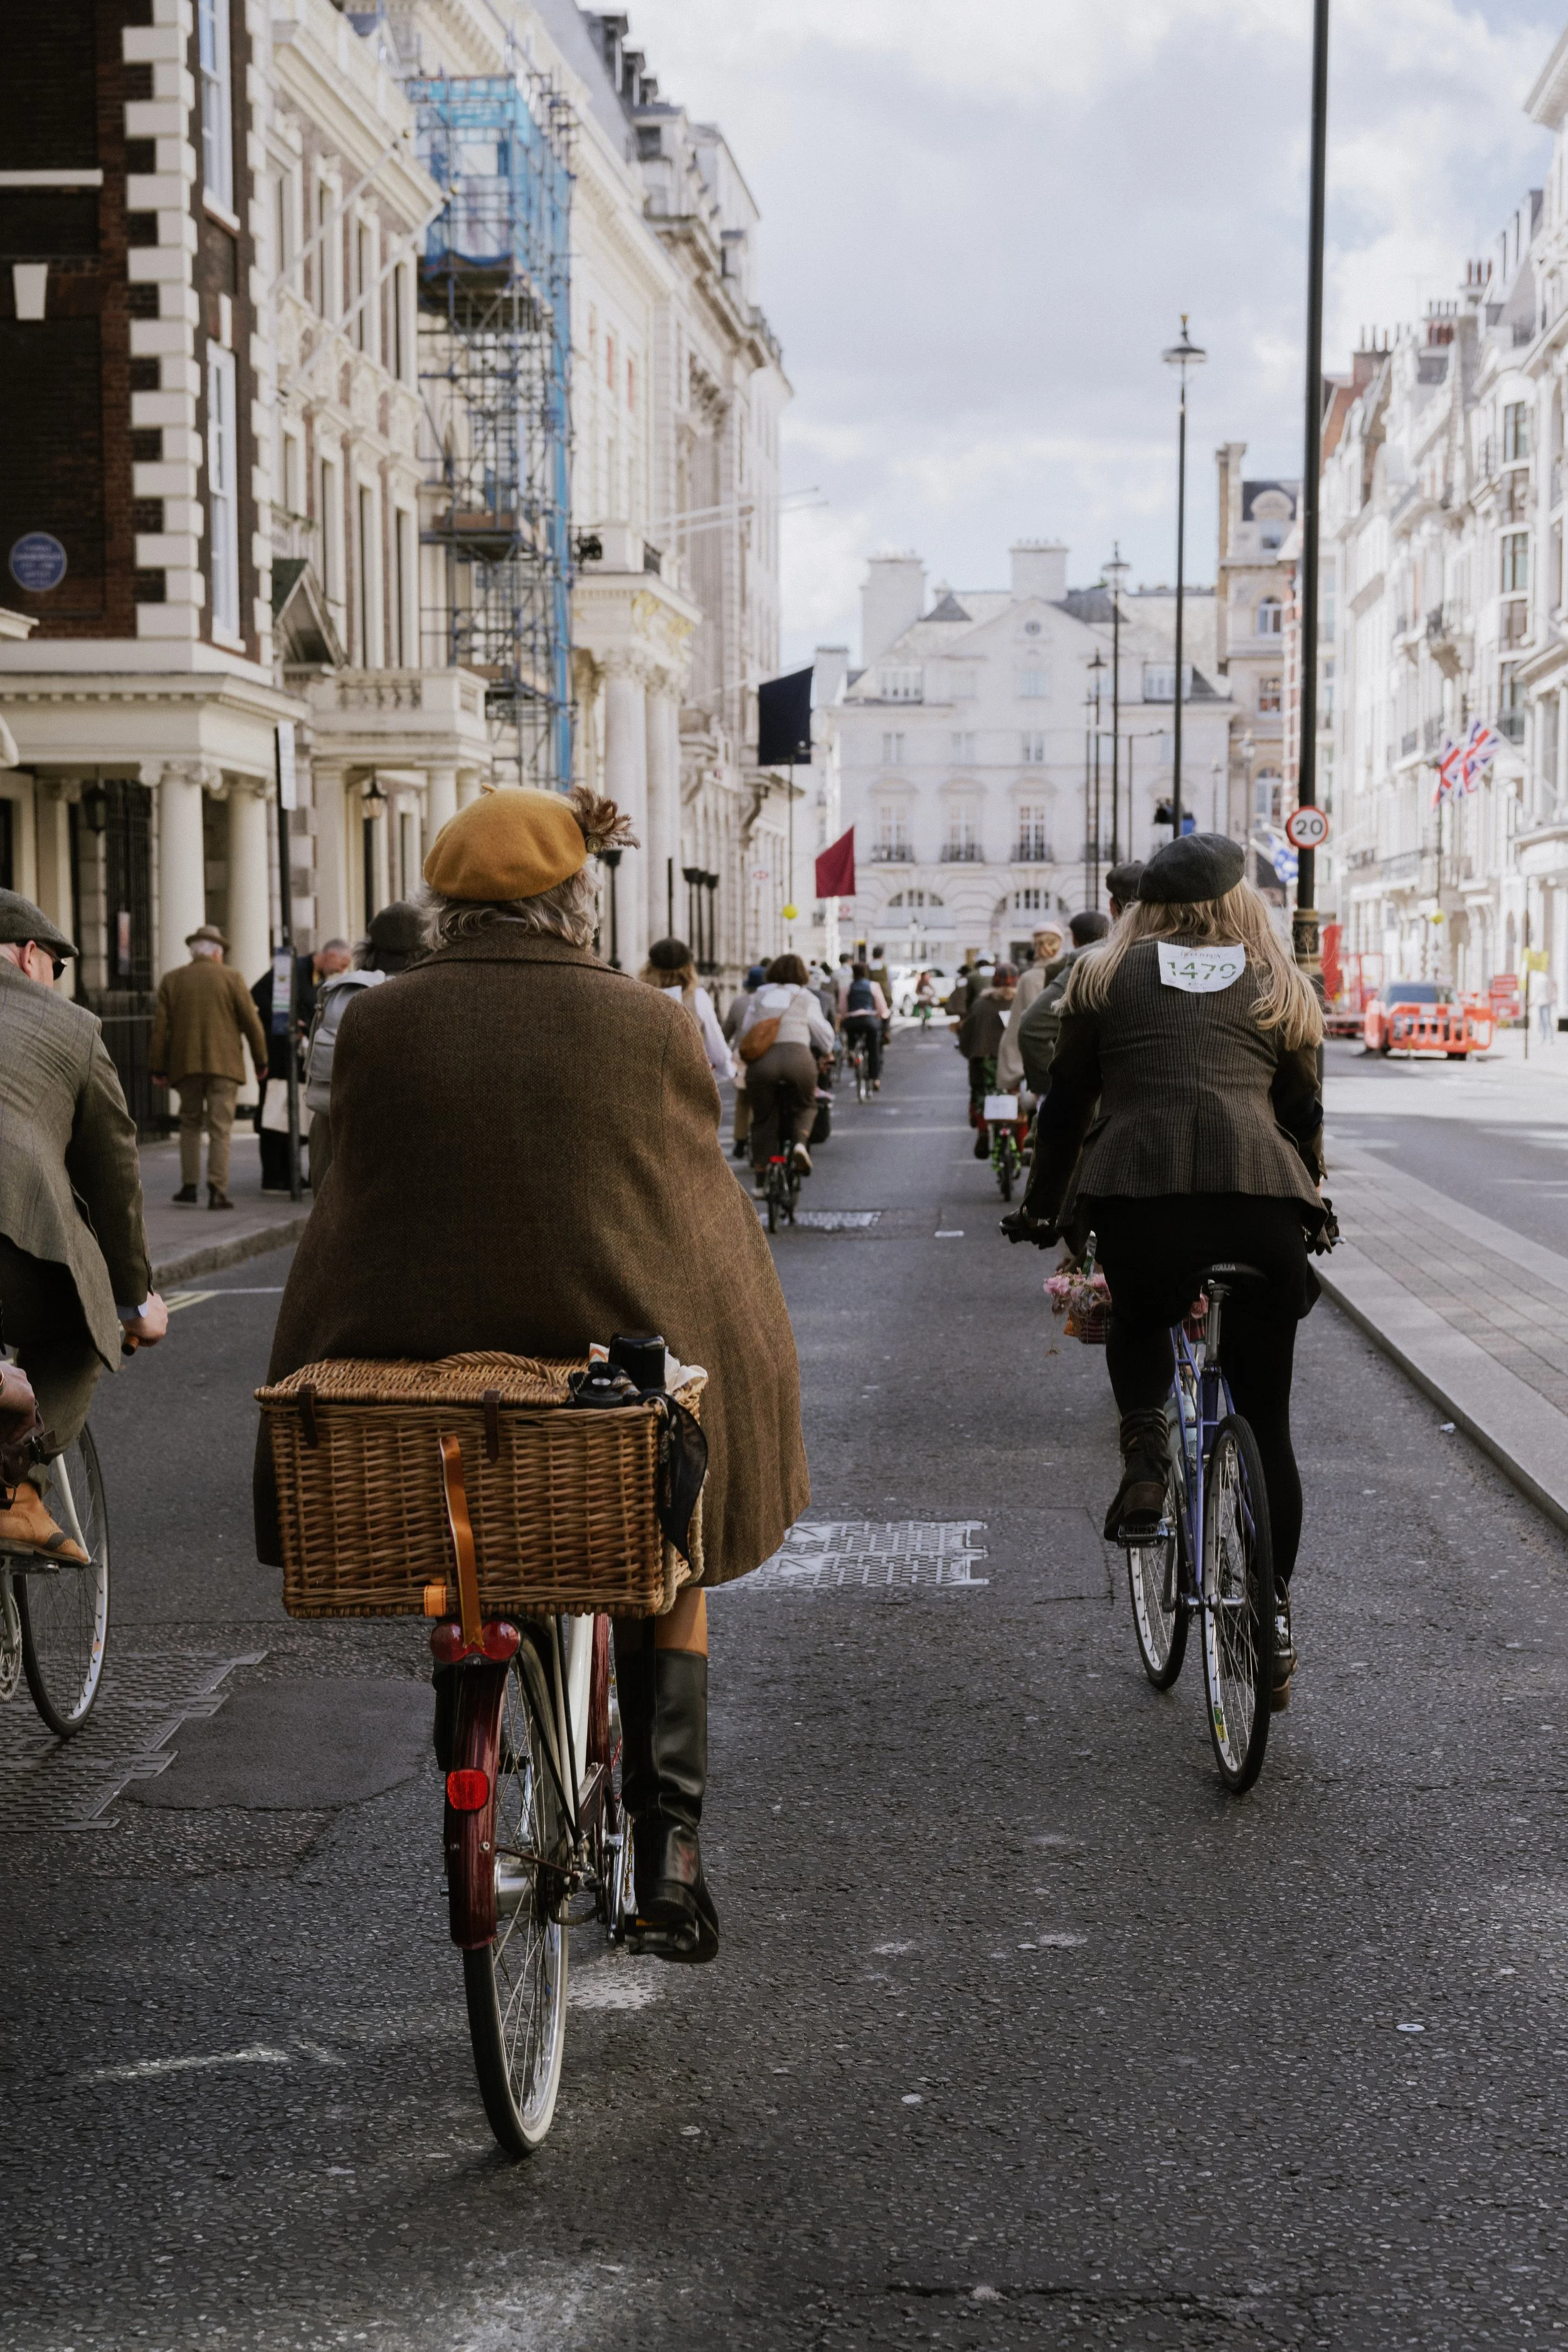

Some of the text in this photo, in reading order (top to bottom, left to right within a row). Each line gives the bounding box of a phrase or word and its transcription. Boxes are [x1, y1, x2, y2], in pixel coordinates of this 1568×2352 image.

[1296, 819, 1323, 835] 20
[1167, 961, 1237, 980] 1479
[1212, 1263, 1236, 1271] ITALIA
